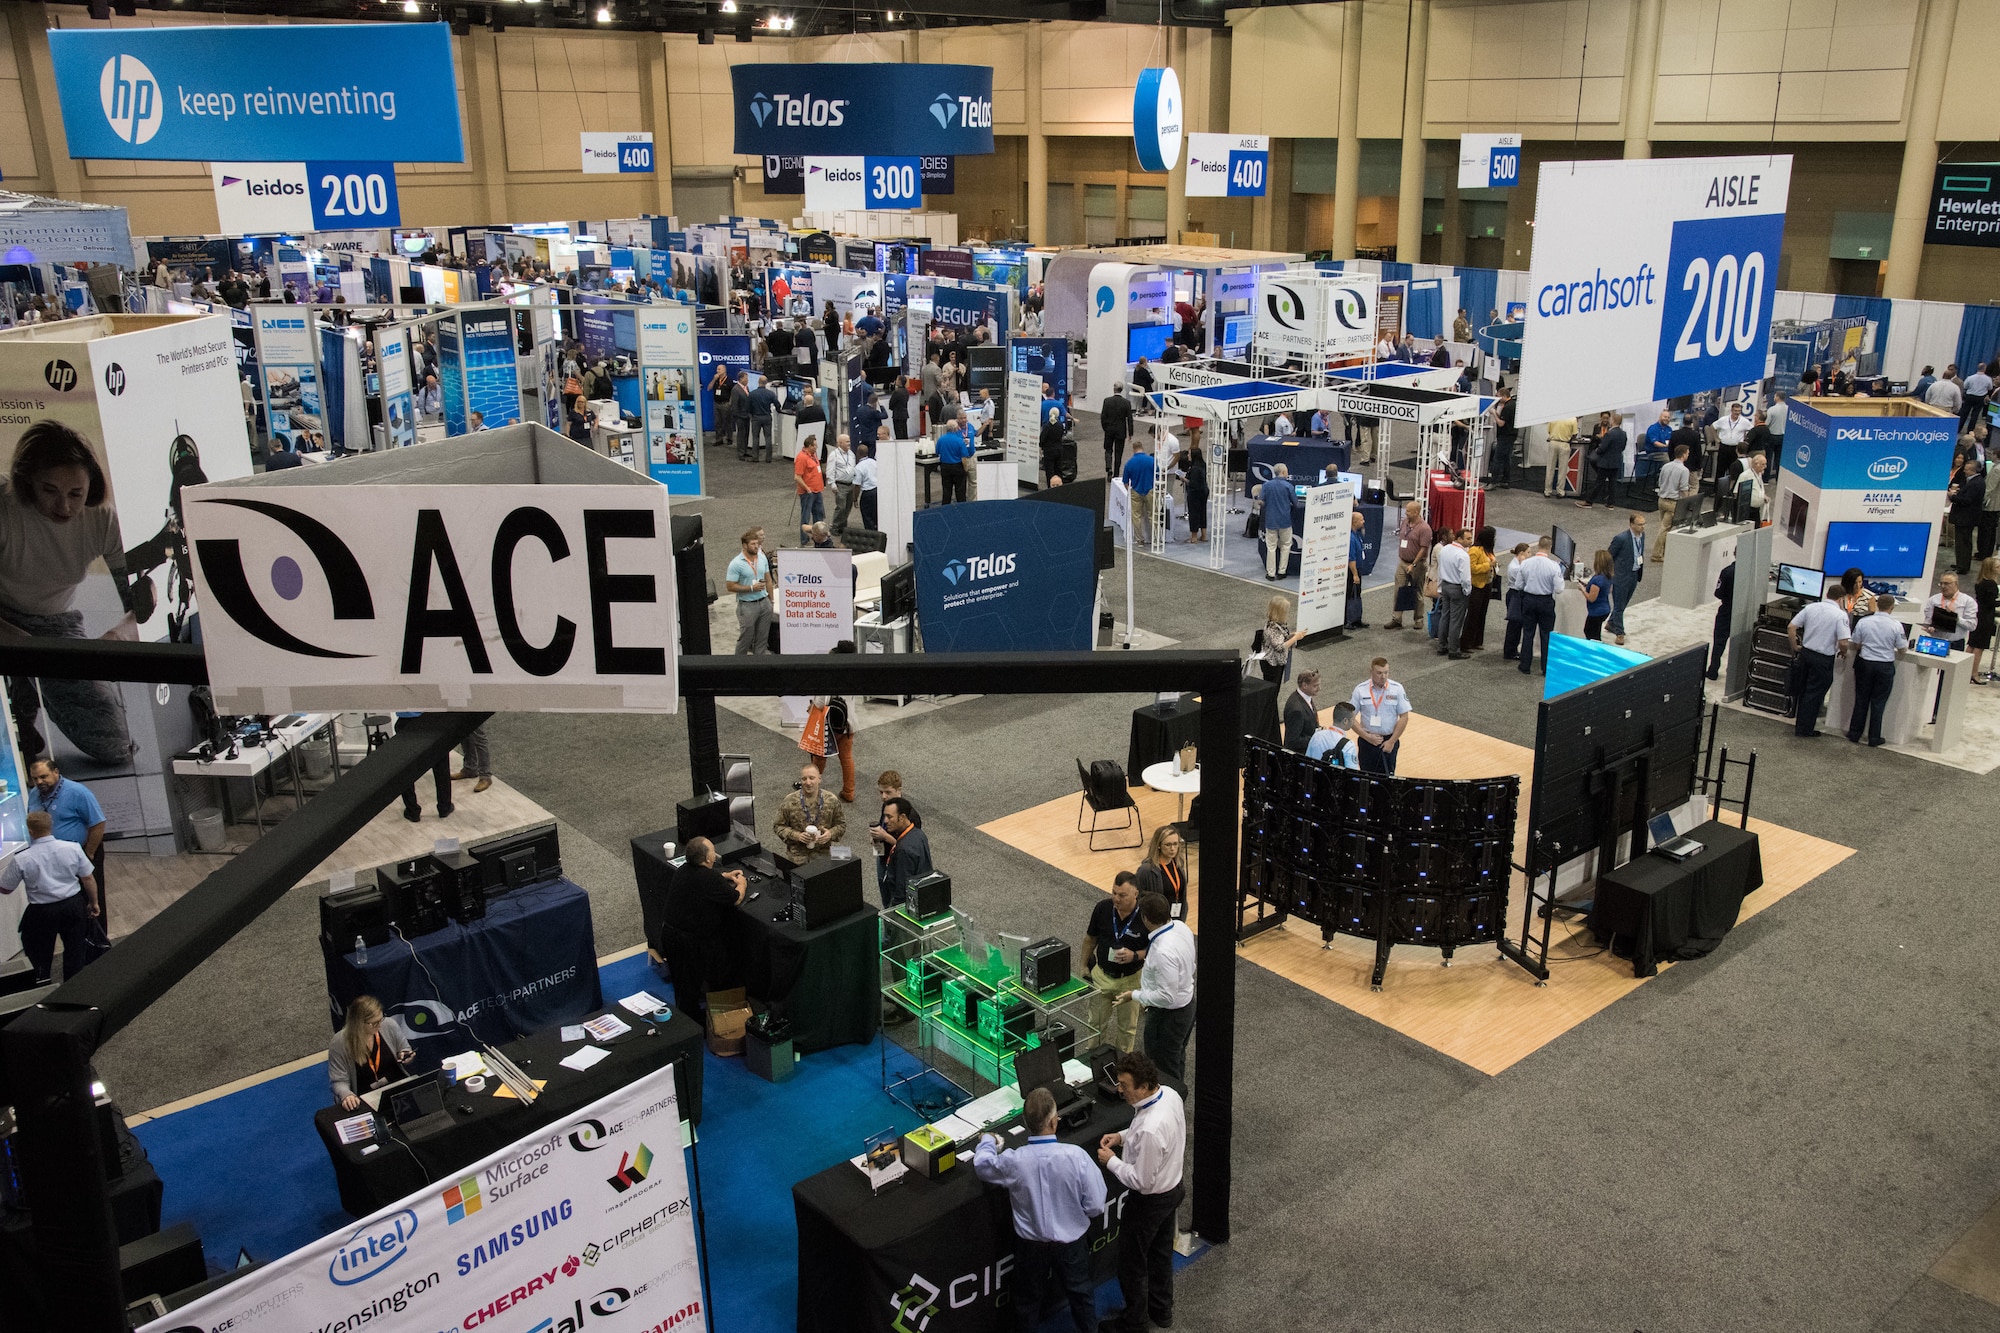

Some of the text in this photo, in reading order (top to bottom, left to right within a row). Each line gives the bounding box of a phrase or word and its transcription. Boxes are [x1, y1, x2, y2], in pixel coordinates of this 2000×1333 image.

[106, 54, 157, 144] hp
[178, 85, 397, 122] keep reinventing
[773, 92, 847, 127] Telos
[958, 95, 993, 129] Telos
[1239, 139, 1259, 149] AISLE
[1499, 137, 1513, 146] AISLE
[594, 148, 650, 168] leidos 400
[1493, 155, 1516, 179] 500
[825, 165, 914, 200] leidos 300
[1201, 159, 1263, 189] leidos 400
[246, 172, 388, 217] leidos 200
[1706, 173, 1761, 209] AISLE
[0, 226, 107, 237] nformation
[1935, 214, 2000, 235] Enterpri
[1139, 291, 1167, 299] perspecta
[1230, 283, 1255, 292] perspecta
[935, 305, 981, 327] SEGUE
[1538, 250, 1765, 362] carahsoft 200
[157, 339, 227, 365] The World's Most Secure
[48, 360, 75, 392] hp
[108, 363, 124, 396] hp
[181, 361, 205, 376] Printers
[205, 358, 216, 370] and
[1169, 368, 1222, 386] Kensington
[0, 399, 45, 410] ission is
[1231, 396, 1294, 416] TOUGHBOOK
[1340, 399, 1415, 418] TOUGHBOOK
[0, 414, 31, 424] ssion
[1788, 409, 1828, 439] DELL Technologies
[1837, 428, 1950, 445] DELL Technologies
[1863, 493, 1902, 503] AKIMA
[1323, 511, 1345, 522] PARTNERS
[1867, 507, 1895, 517] Affigent
[796, 572, 823, 584] Telos
[966, 552, 1016, 582] Telos
[400, 505, 666, 678] ACE
[785, 589, 826, 601] Security &
[943, 580, 1019, 604] Solutions that empower and
[943, 590, 1005, 612] protect the enterprise.
[785, 599, 831, 611] Compliance
[786, 609, 837, 620] Data at Scale
[485, 1135, 562, 1185] Microsoft
[489, 1162, 549, 1203] Surface
[605, 1179, 662, 1214] imagePROGRAF
[457, 1198, 573, 1277] SAMSUNG
[621, 1207, 692, 1250] data security
[336, 1215, 408, 1275] intel
[210, 1282, 305, 1333] ACECOMPUTERS
[311, 1271, 440, 1333] Kensington
[463, 1266, 558, 1331] CHERRY
[641, 1300, 701, 1333] anon
